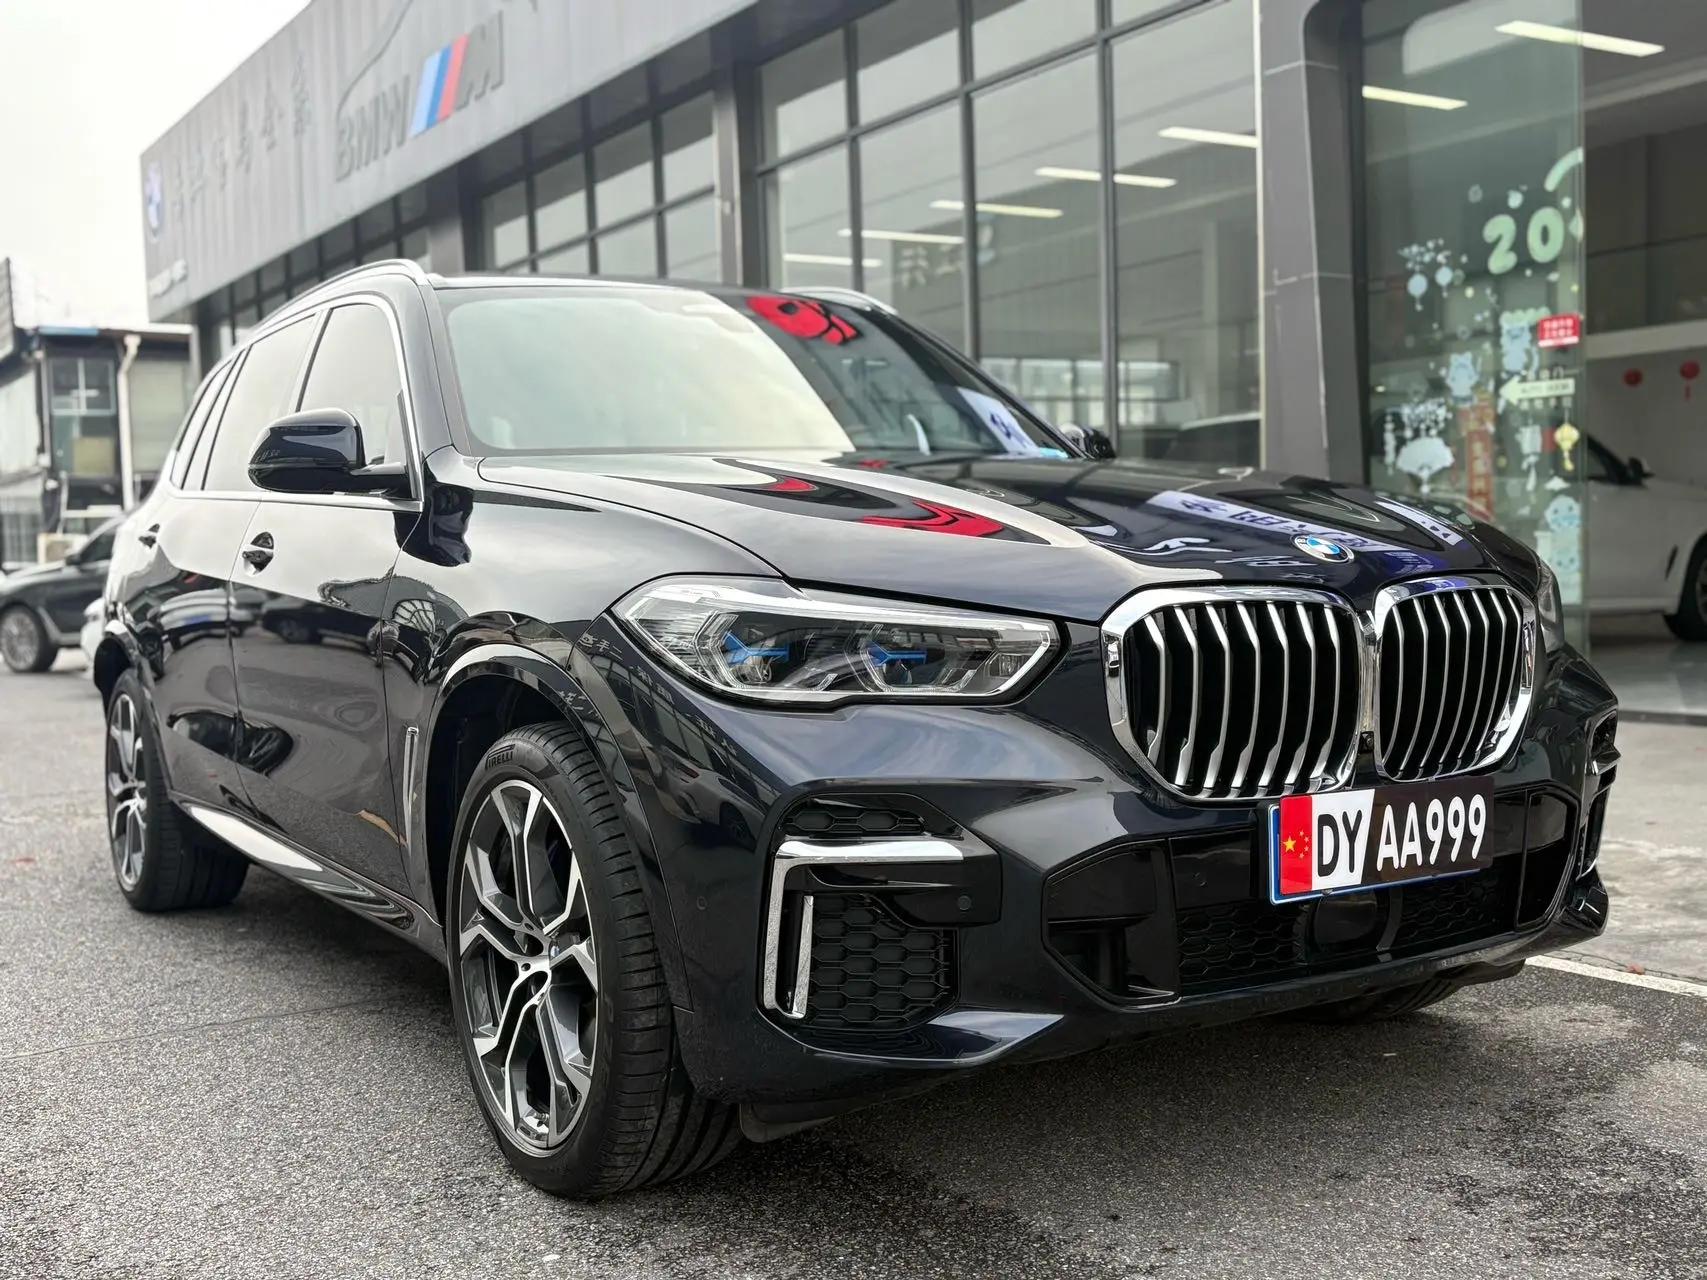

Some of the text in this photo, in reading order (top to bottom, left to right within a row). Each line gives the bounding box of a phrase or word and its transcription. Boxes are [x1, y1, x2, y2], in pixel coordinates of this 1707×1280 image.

[335, 74, 411, 183] BMW
[485, 744, 515, 770] PIRELLI
[1317, 793, 1487, 878] DY AA999
